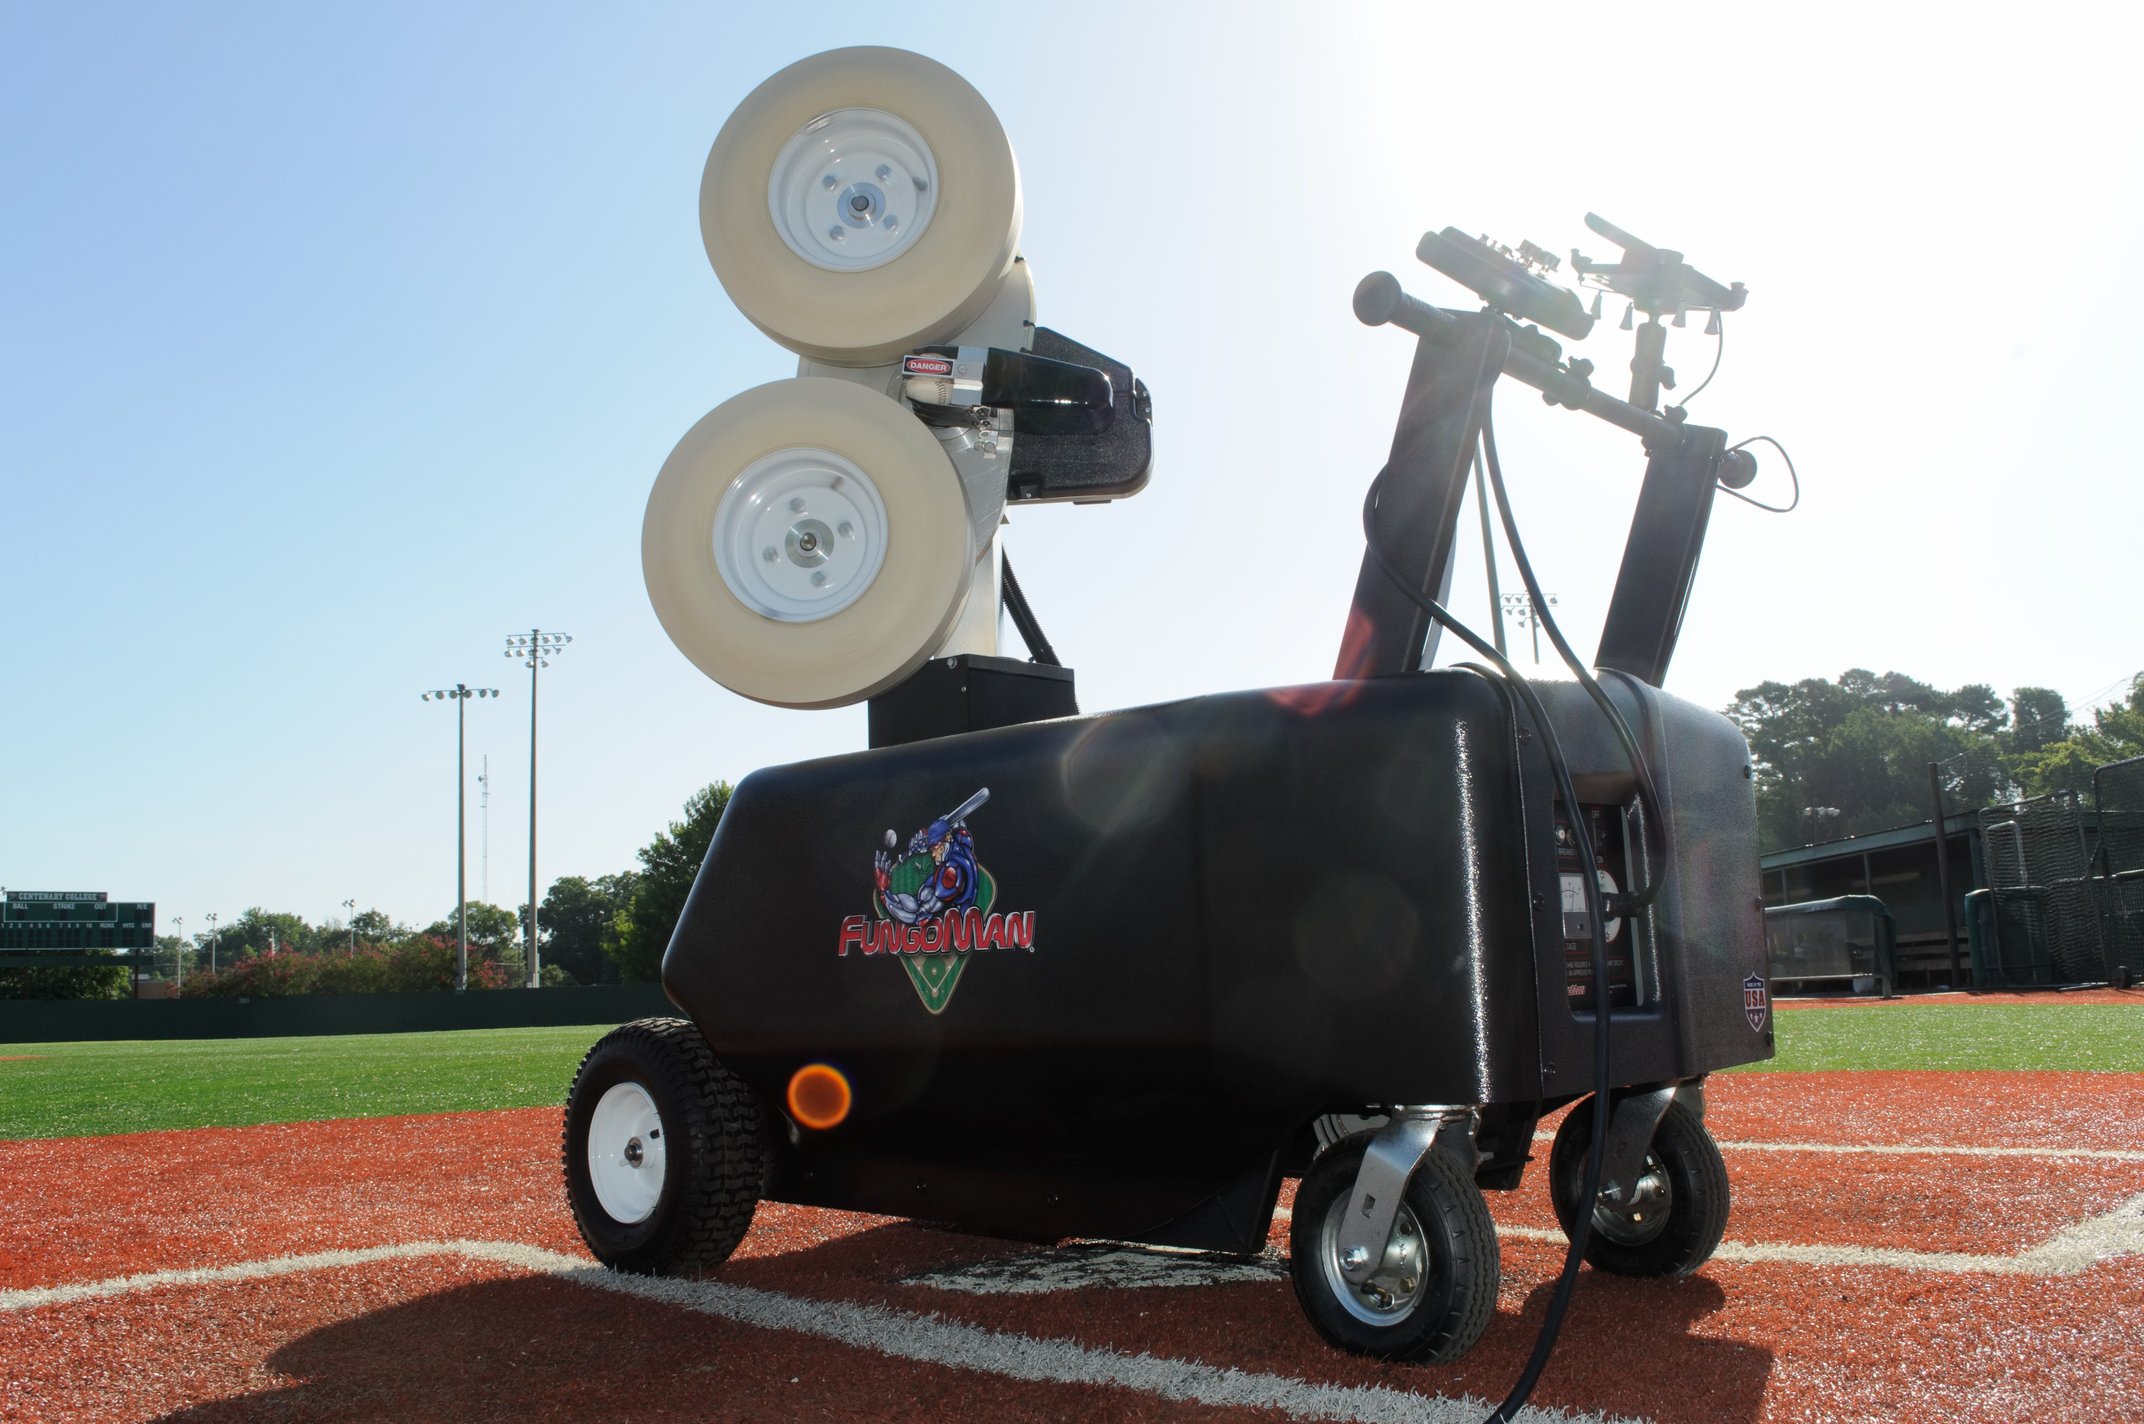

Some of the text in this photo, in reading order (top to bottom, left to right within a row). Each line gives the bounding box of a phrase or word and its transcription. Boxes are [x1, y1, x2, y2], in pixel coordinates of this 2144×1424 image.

[910, 361, 947, 371] DANGER
[18, 892, 97, 901] CENTENARY COLLEGE
[1745, 990, 1765, 1008] USA
